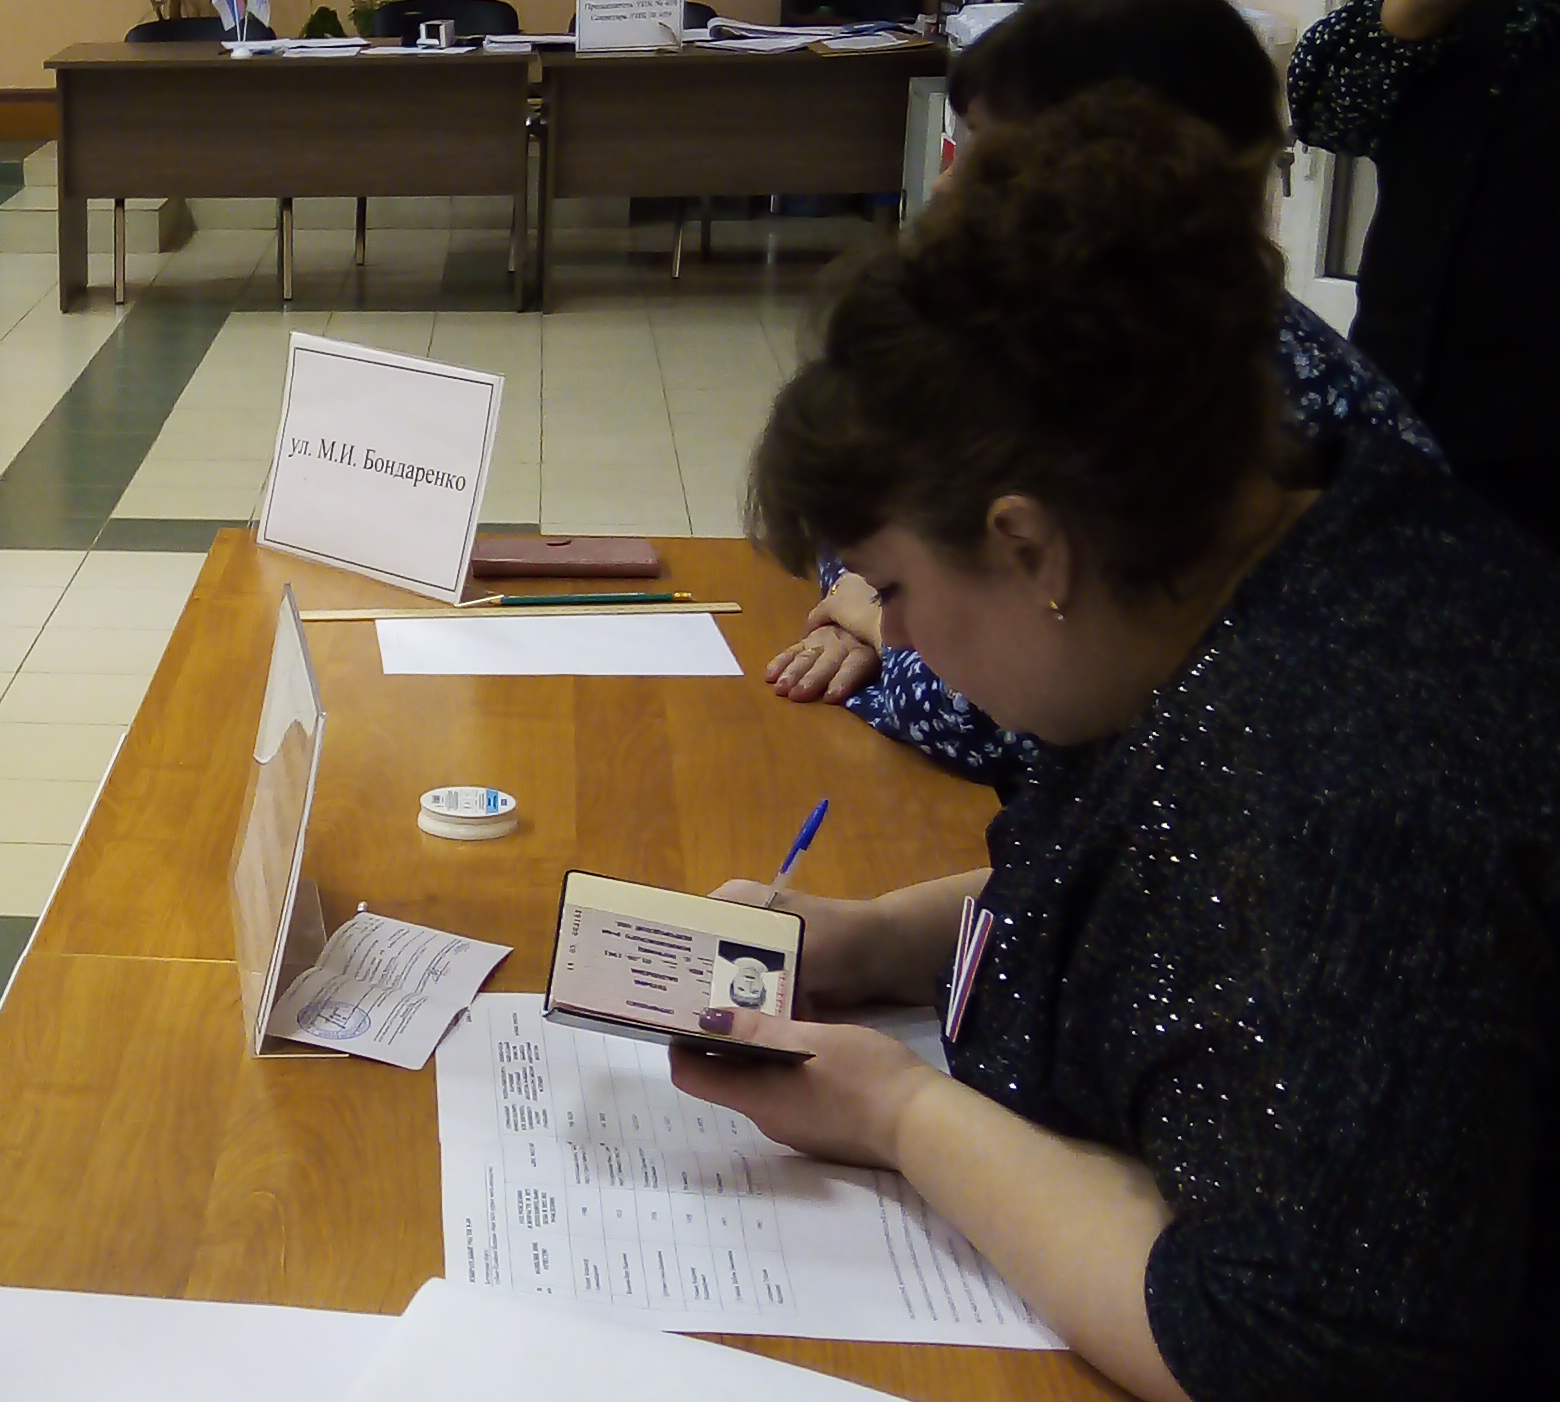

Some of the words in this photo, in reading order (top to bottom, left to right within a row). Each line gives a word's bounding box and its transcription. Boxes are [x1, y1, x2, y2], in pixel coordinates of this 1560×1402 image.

[288, 437, 312, 458] ул.
[317, 438, 357, 467] М.И.
[363, 448, 467, 492] Бондаренко
